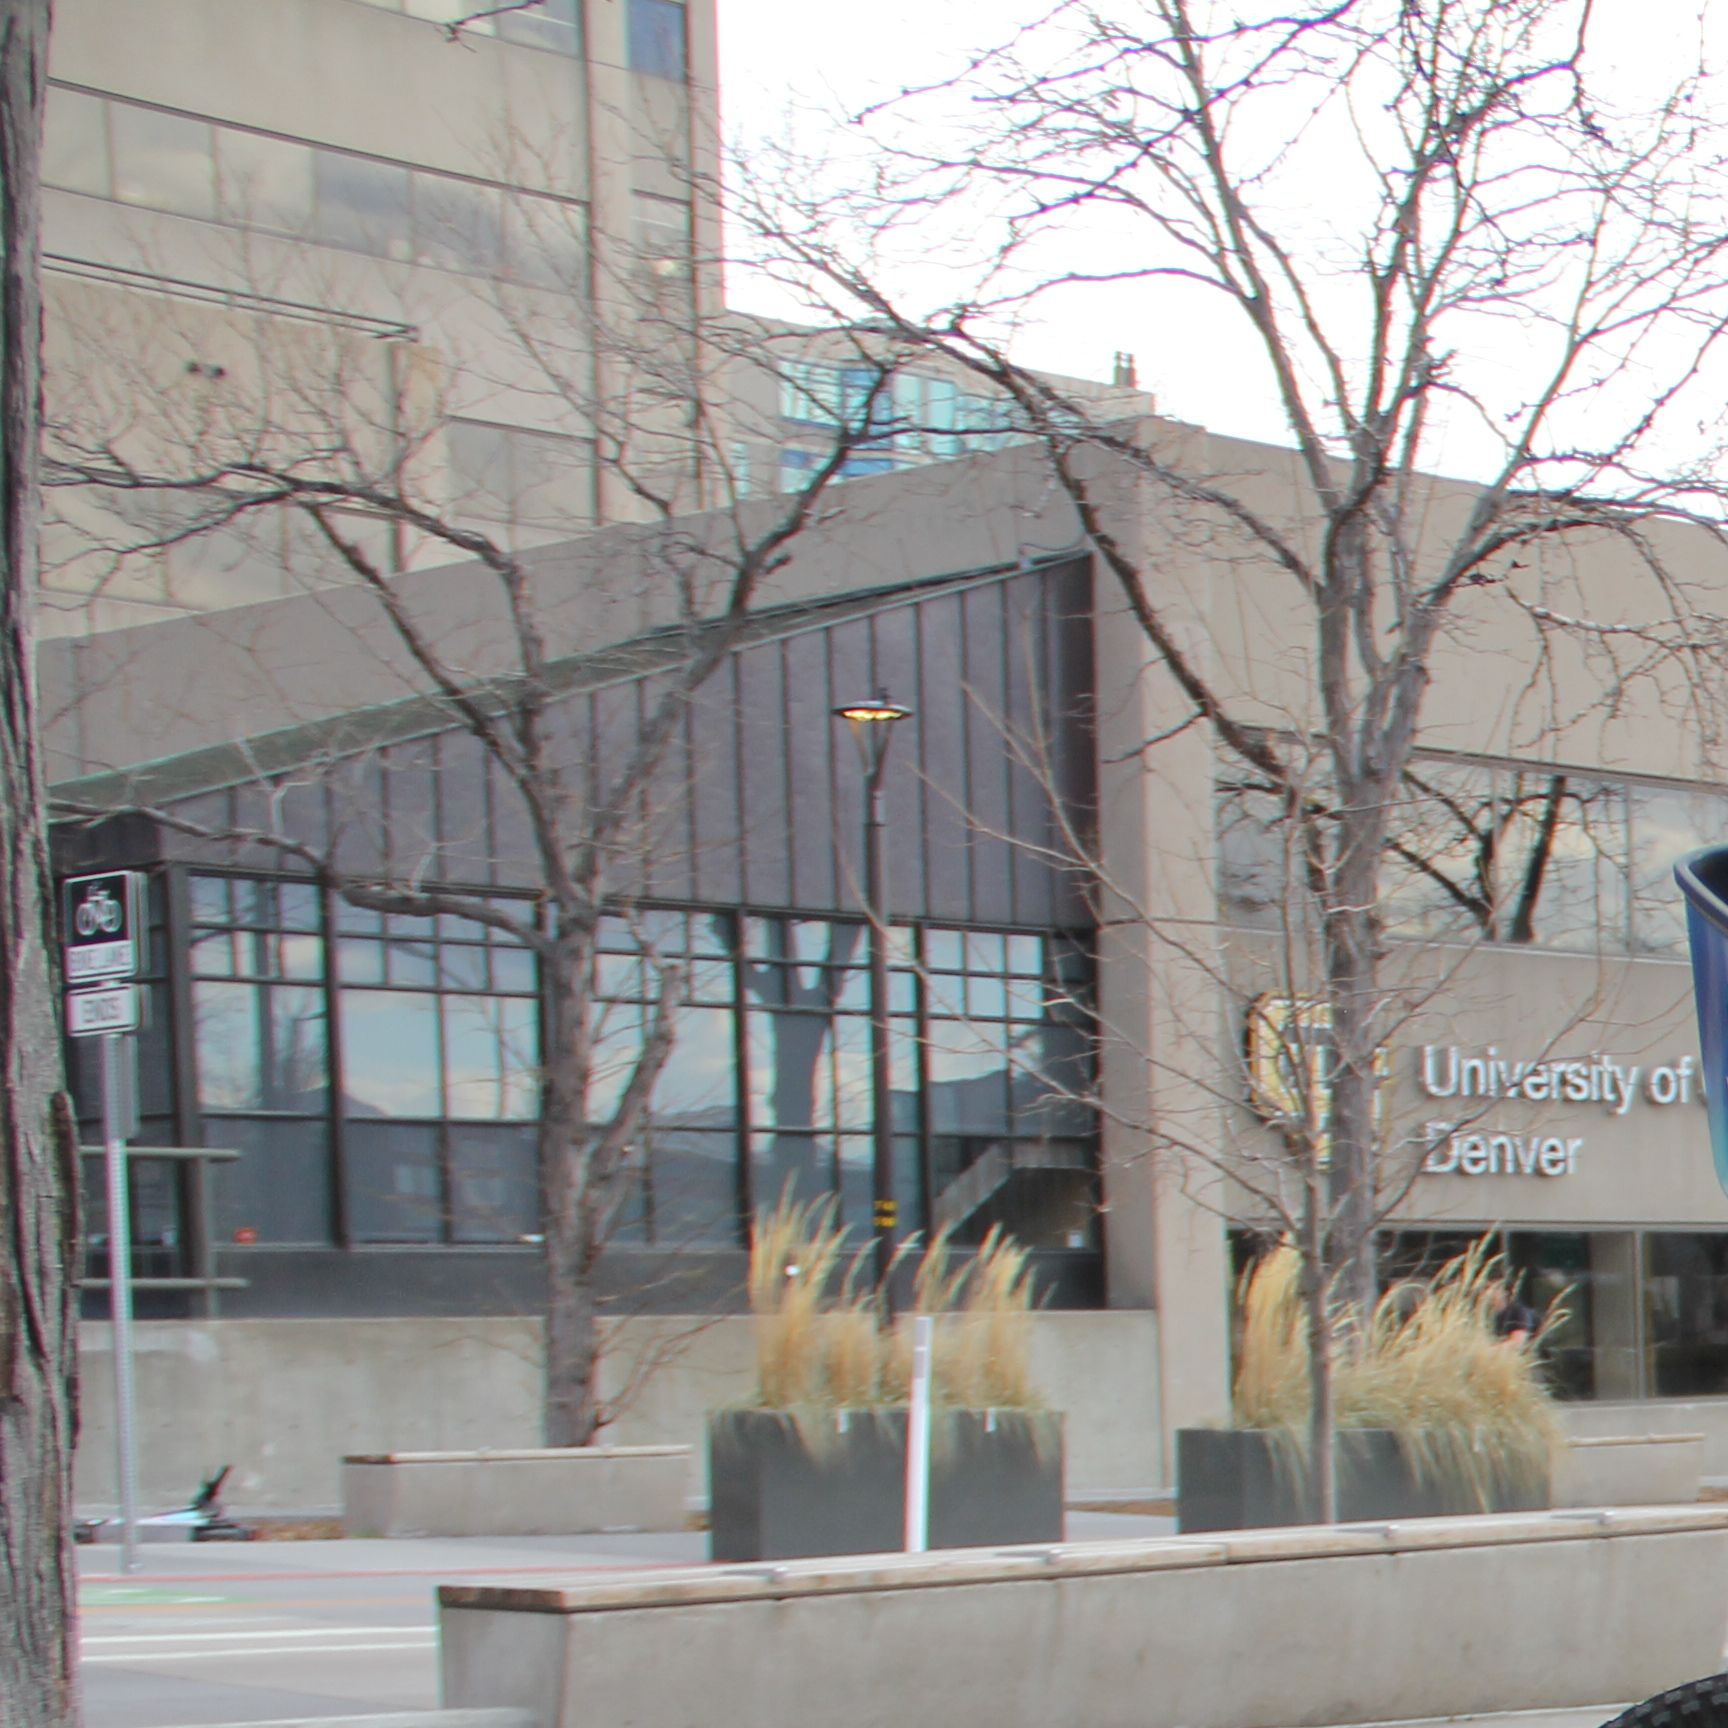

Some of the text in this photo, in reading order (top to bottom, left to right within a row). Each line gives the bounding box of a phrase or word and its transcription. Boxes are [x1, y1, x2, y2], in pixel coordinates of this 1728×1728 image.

[1420, 1045, 1696, 1115] University of
[1420, 1121, 1585, 1177] Denver
